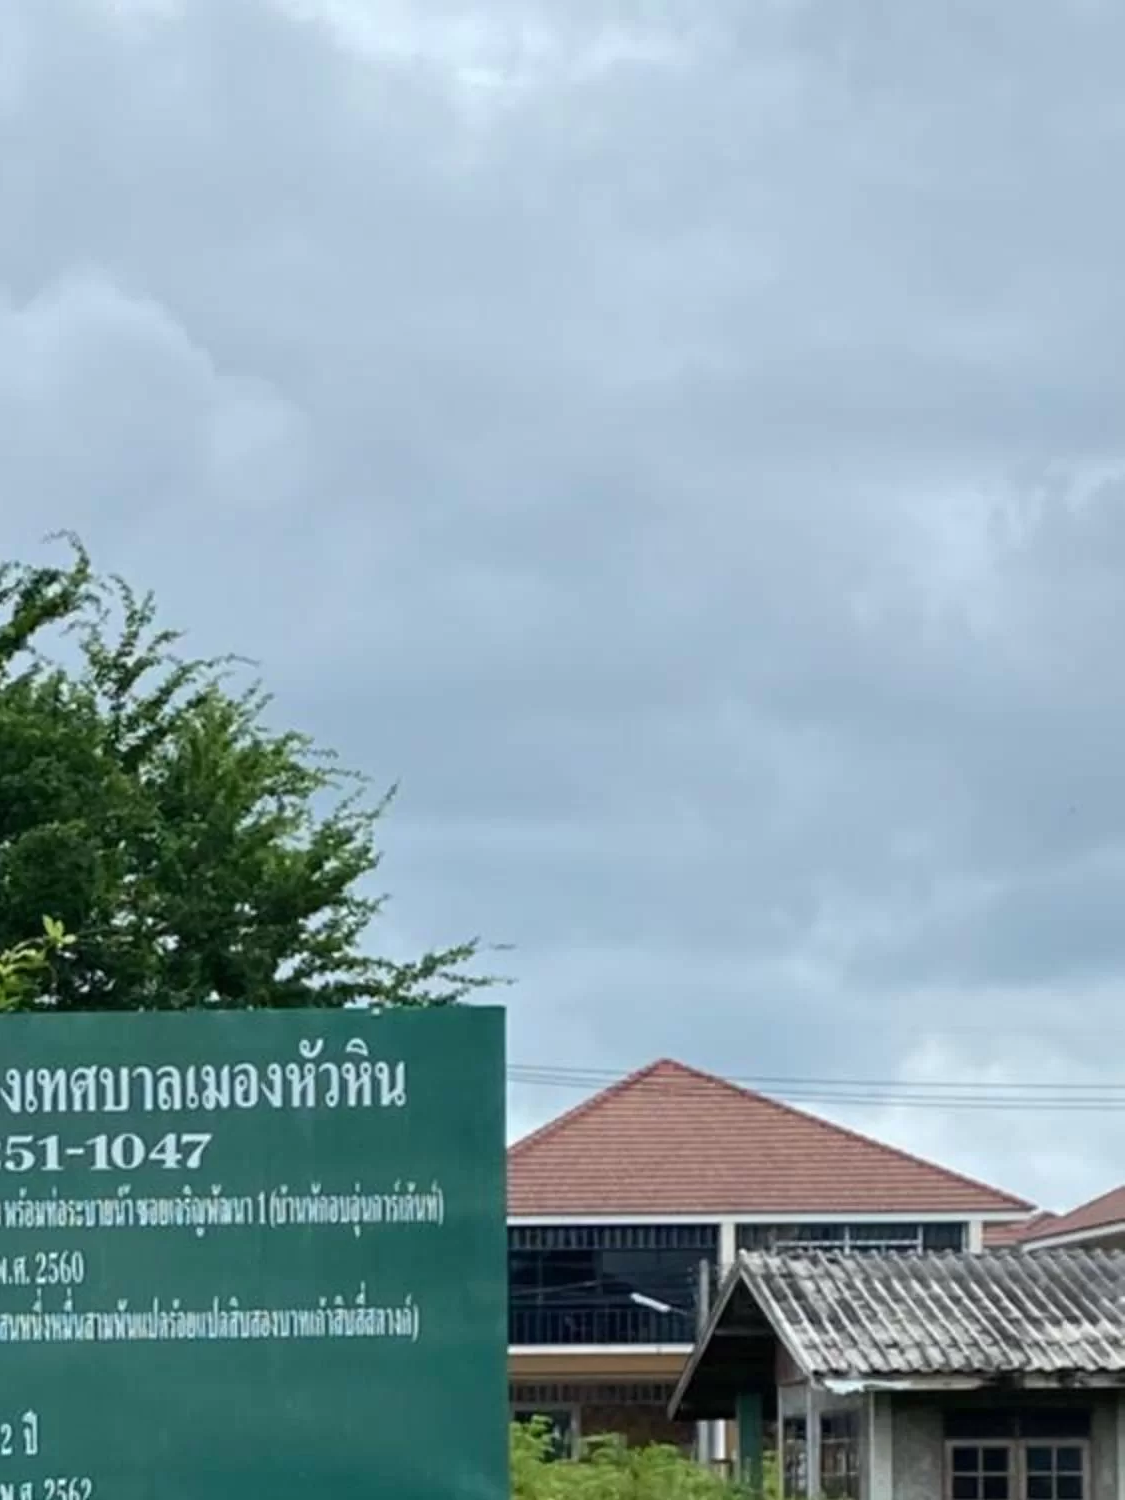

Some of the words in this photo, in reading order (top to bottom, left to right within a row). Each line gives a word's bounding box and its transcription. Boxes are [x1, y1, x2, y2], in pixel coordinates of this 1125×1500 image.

[35, 1251, 84, 1284] 2560
[0, 1424, 13, 1455] 2
[22, 1410, 38, 1455] ปี
